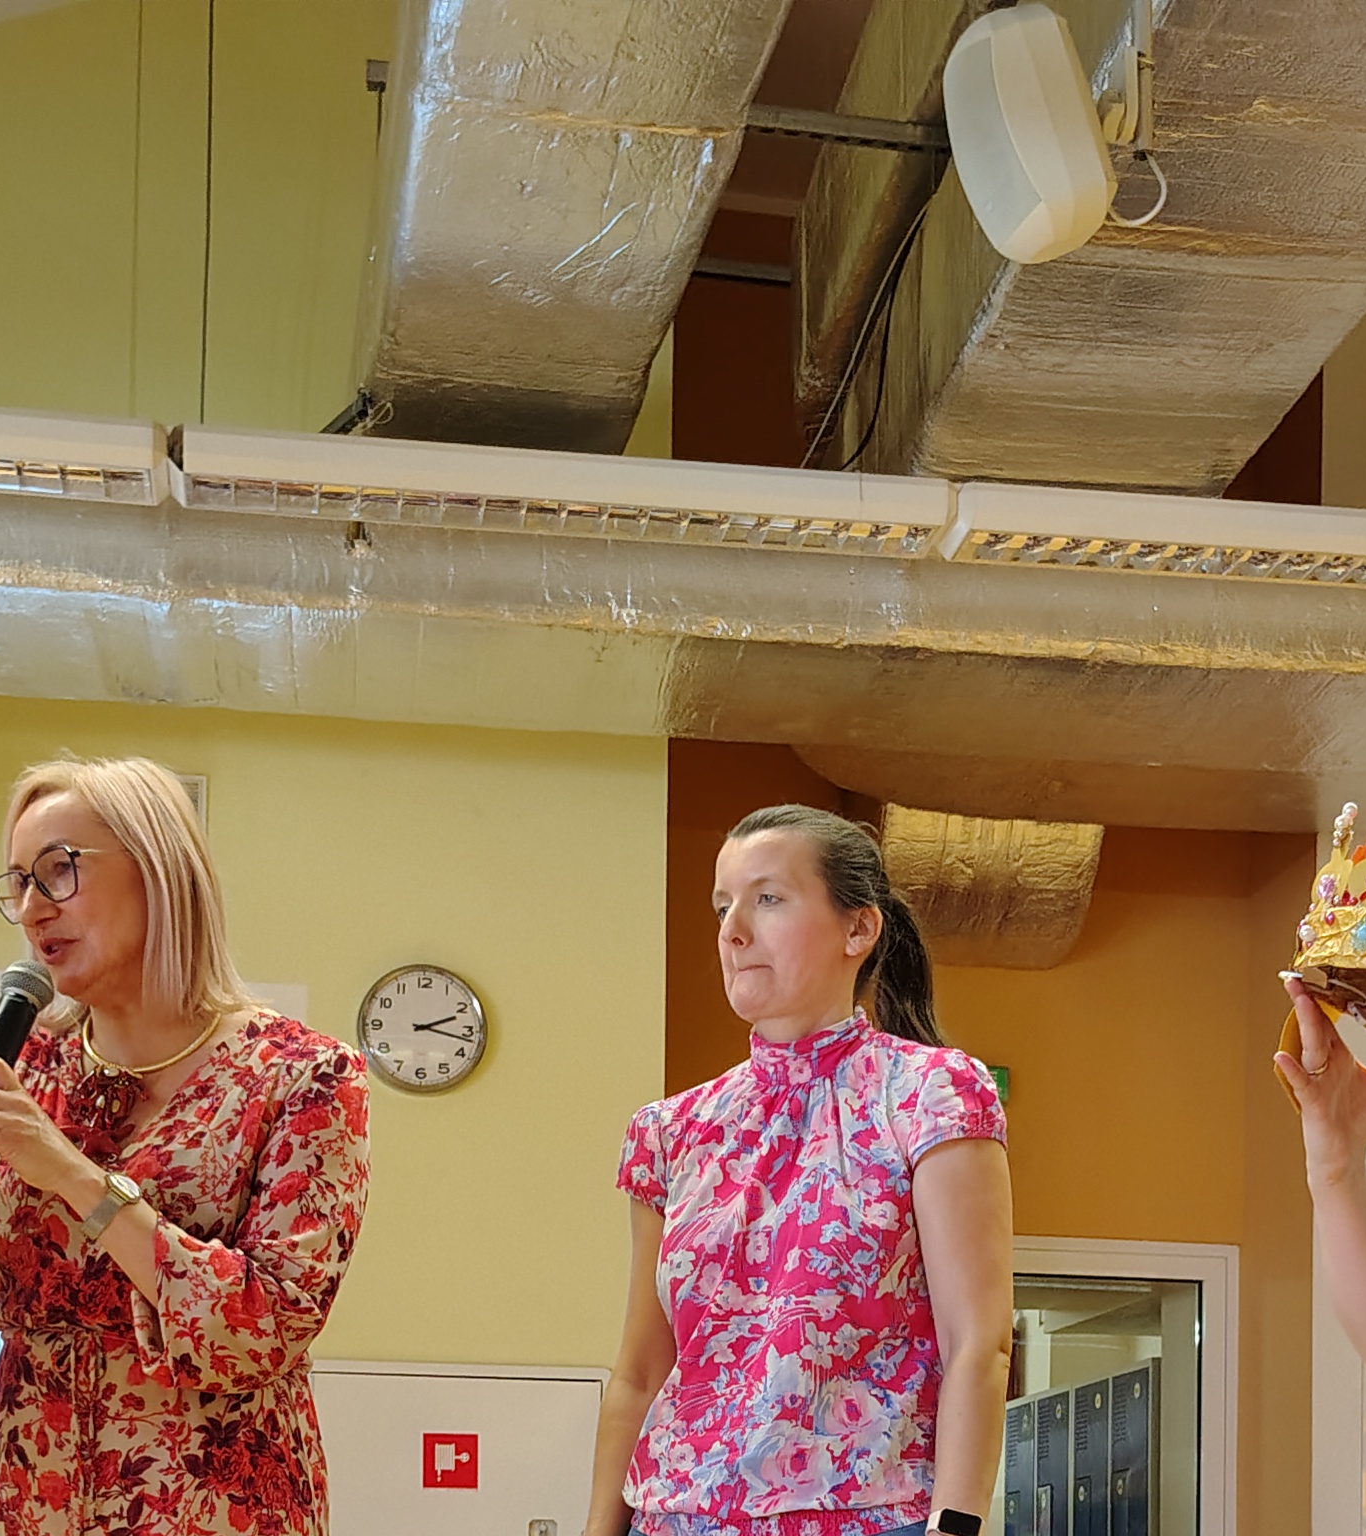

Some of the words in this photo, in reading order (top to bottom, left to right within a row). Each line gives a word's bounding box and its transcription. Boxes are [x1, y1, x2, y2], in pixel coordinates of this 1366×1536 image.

[397, 983, 406, 995] 11
[417, 977, 433, 989] 12
[380, 997, 392, 1009] 10
[456, 1002, 468, 1014] 2
[371, 1019, 383, 1031] 9
[461, 1025, 474, 1038] 3
[378, 1042, 390, 1054] 8
[454, 1047, 466, 1059] 4
[393, 1060, 404, 1073] 7
[438, 1063, 450, 1075] 5
[415, 1067, 427, 1079] 6
